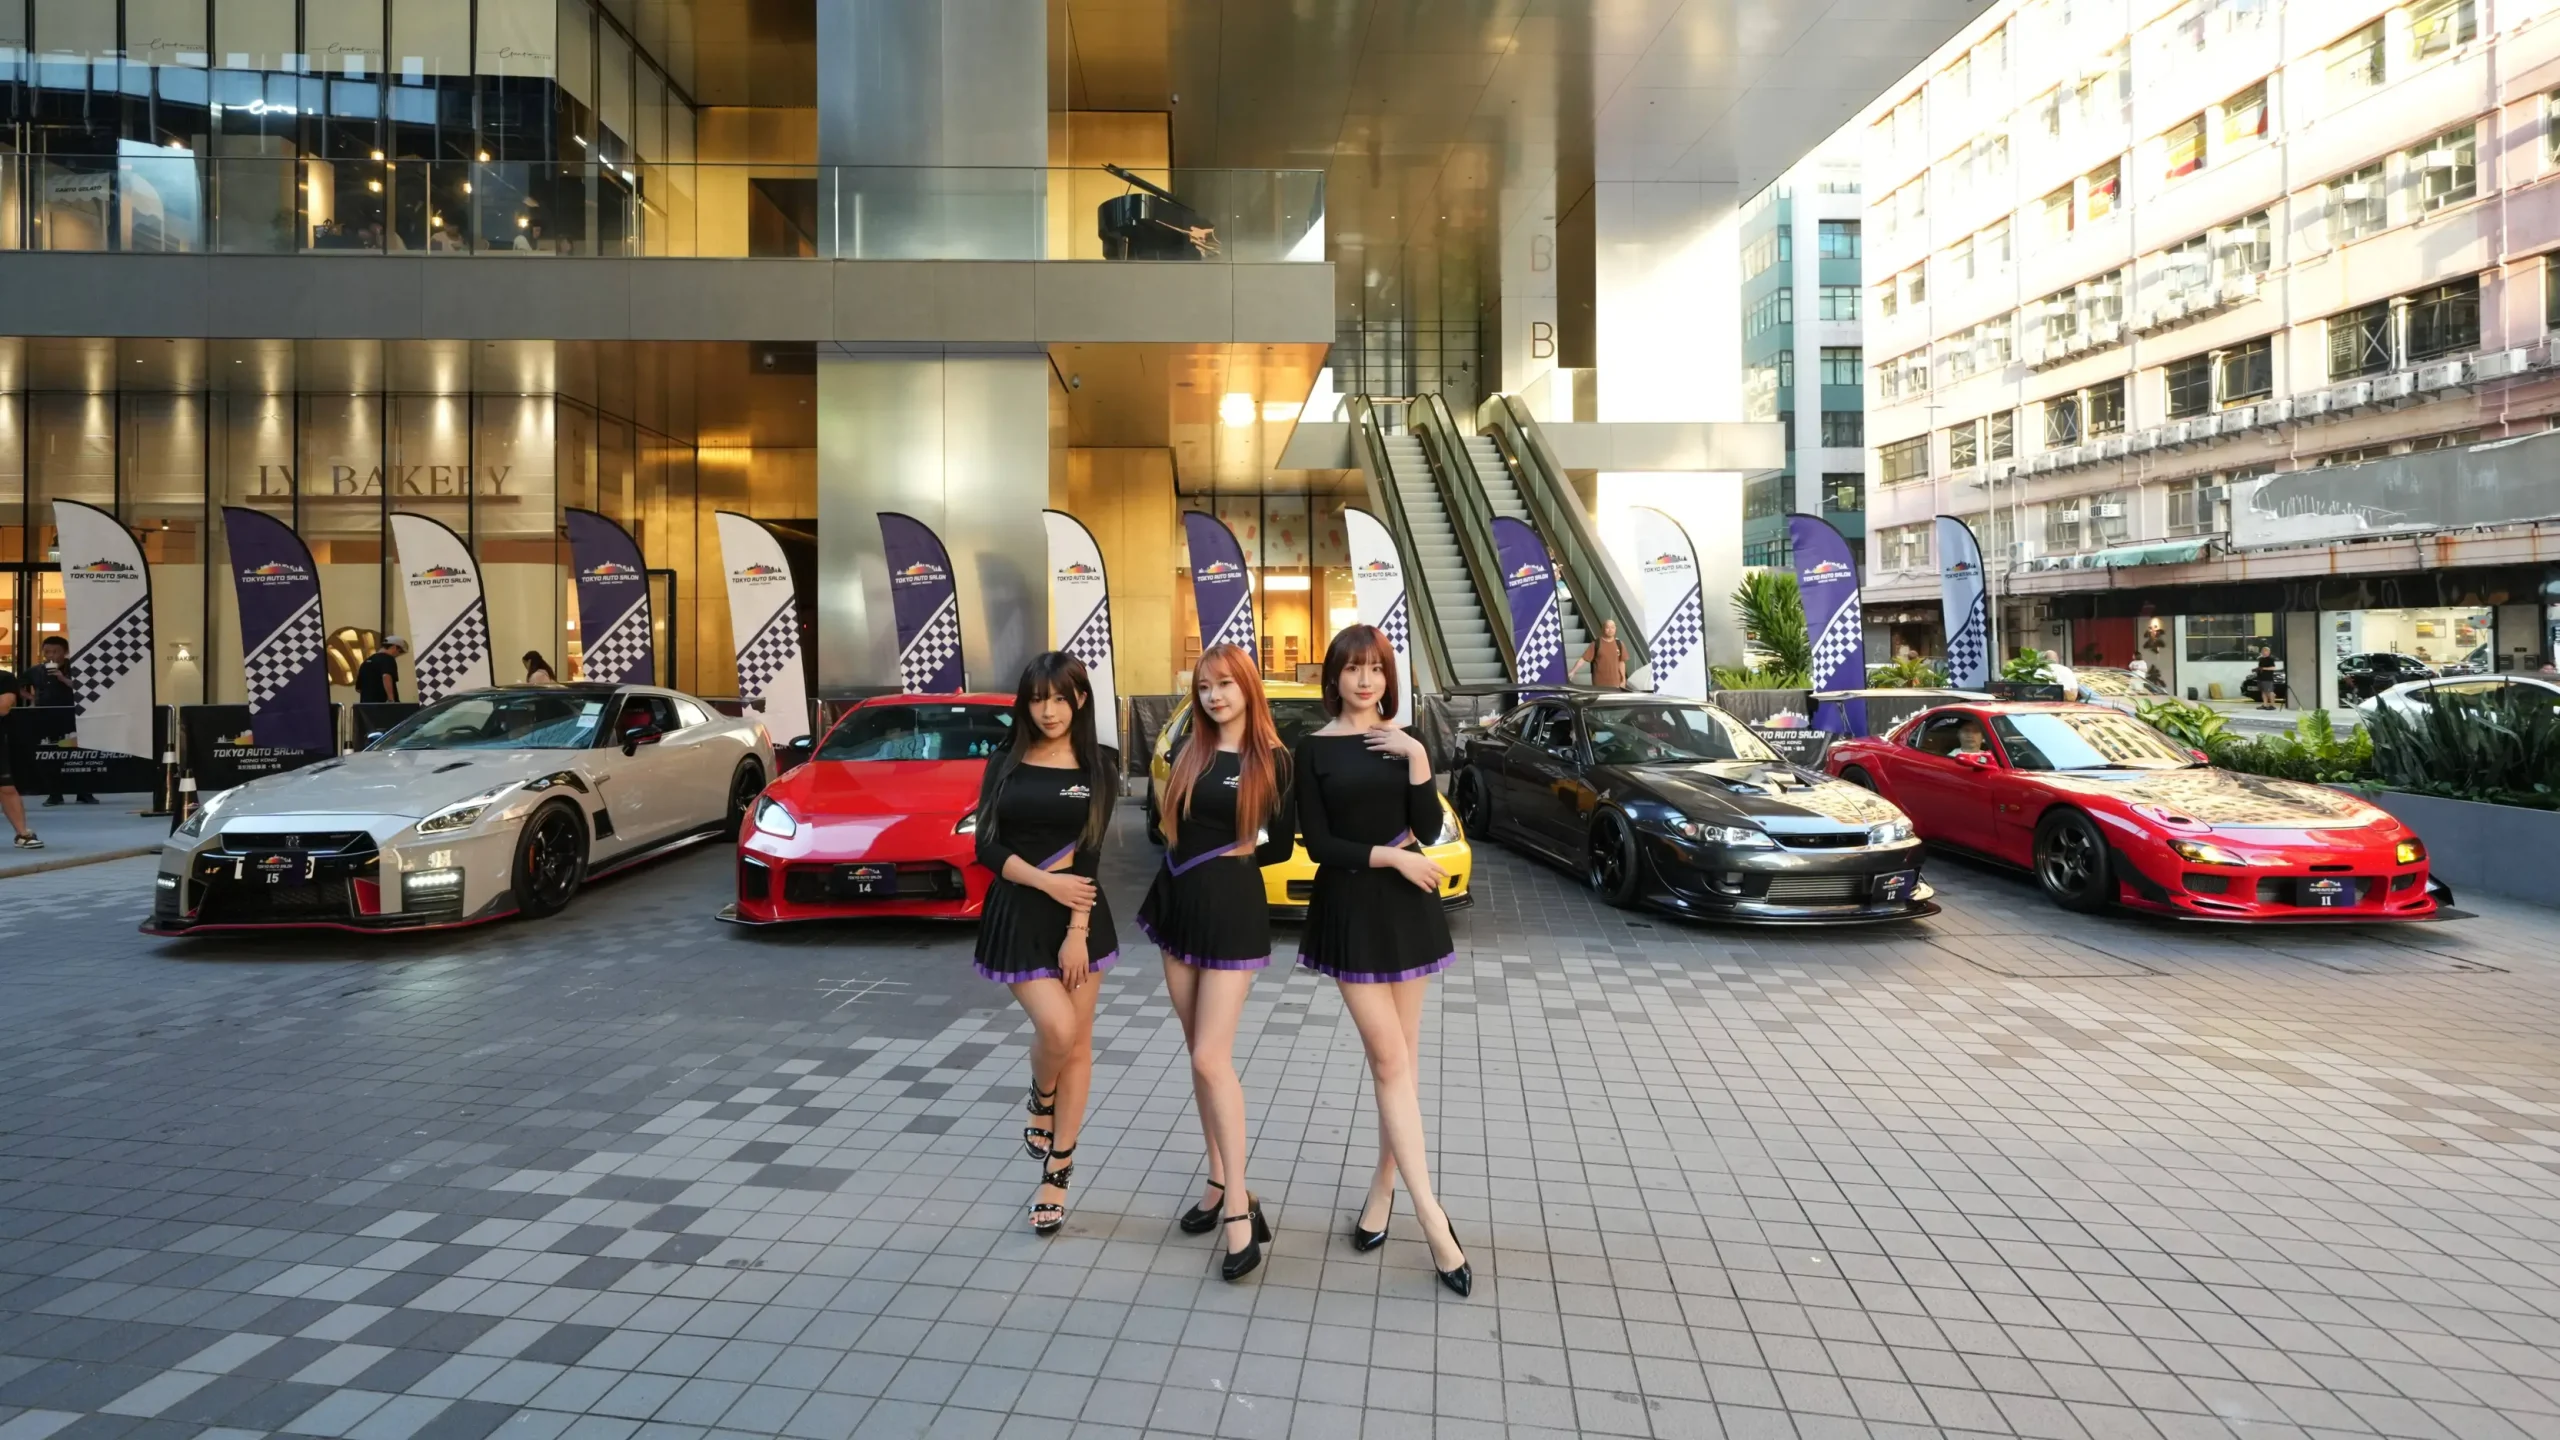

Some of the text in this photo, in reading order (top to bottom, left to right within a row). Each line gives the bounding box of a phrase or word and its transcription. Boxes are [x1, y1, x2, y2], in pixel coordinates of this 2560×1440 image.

[1532, 321, 1555, 358] B
[35, 751, 68, 760] TOKYO
[70, 750, 98, 759] AUTO
[213, 749, 245, 758] TOKYO
[246, 748, 272, 756] AUTO
[266, 873, 280, 883] 15
[859, 883, 872, 892] 14
[1887, 891, 1896, 900] 12
[2321, 896, 2331, 906] 11
